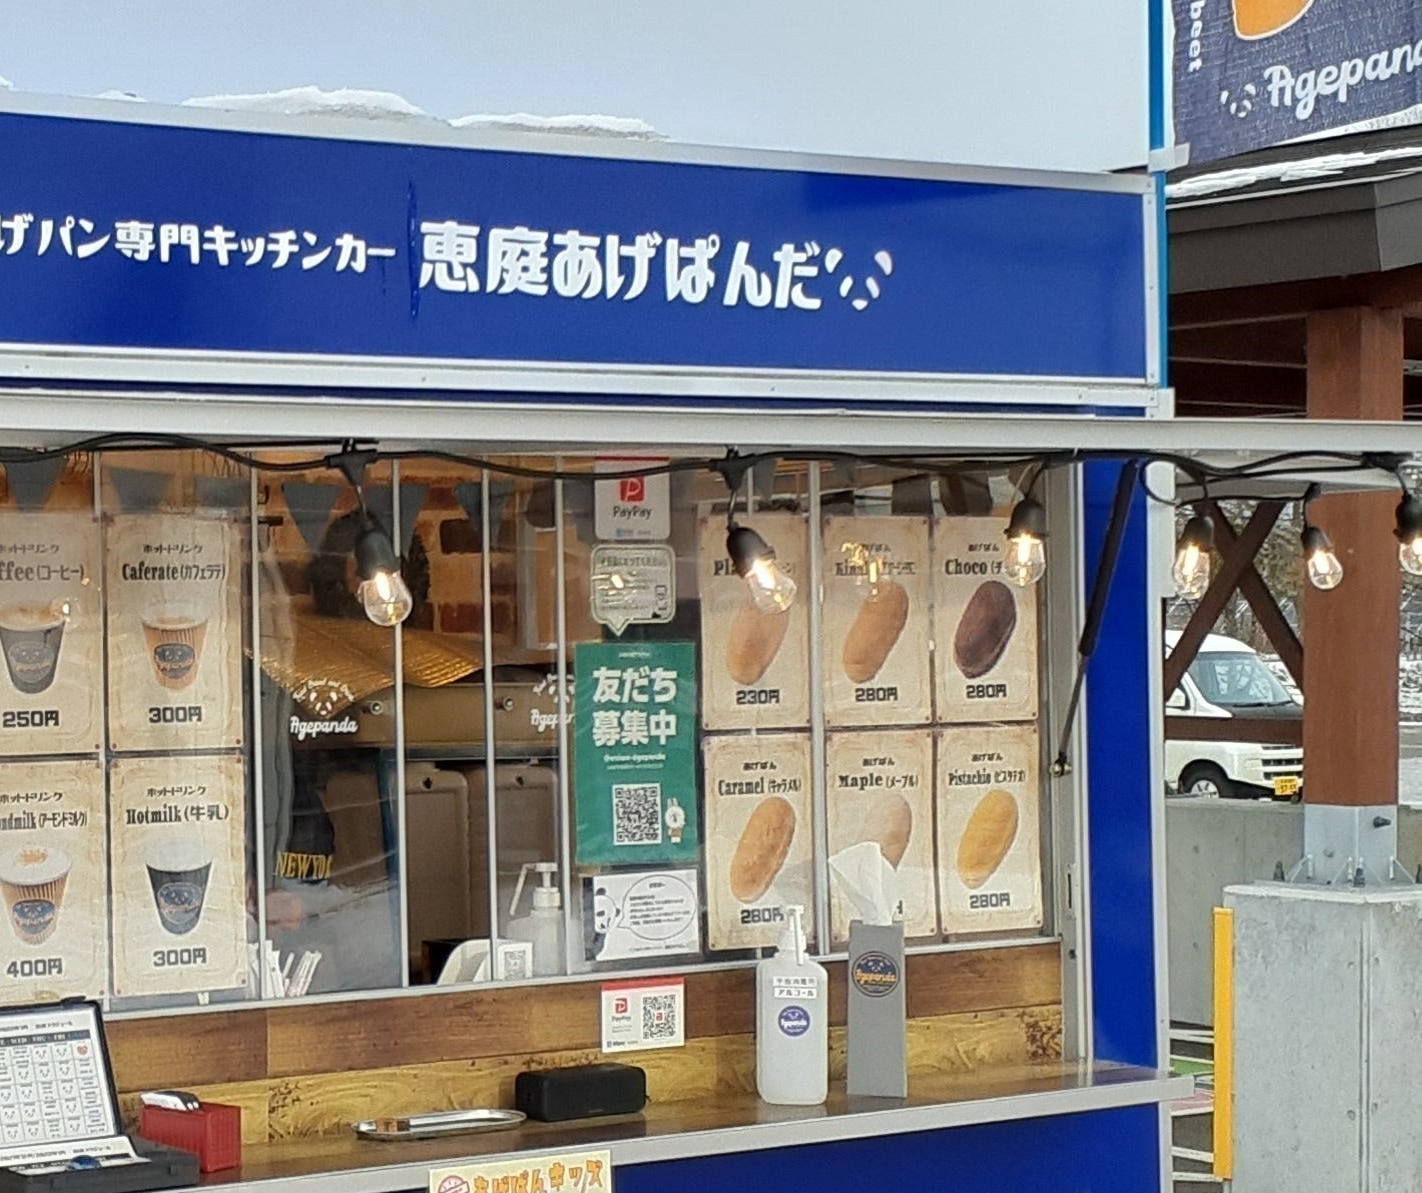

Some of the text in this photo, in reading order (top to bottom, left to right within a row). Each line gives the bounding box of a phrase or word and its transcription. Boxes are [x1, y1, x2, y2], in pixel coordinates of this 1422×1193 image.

[419, 220, 840, 312] 恵庭あげぱんだ
[612, 505, 653, 520] PayPay
[945, 558, 987, 575] Choco
[592, 665, 678, 703] 友だち
[966, 684, 1007, 699] 280円
[736, 688, 781, 705] 230円
[854, 686, 899, 702] 280円
[2, 710, 60, 728] 250円
[149, 706, 203, 723] 300円
[290, 715, 359, 741] Agepanda
[592, 708, 677, 747] 募集中
[718, 776, 765, 796] Caramel
[838, 772, 884, 791] Maple
[125, 803, 230, 825] Hotmilk (牛乳)
[969, 892, 1011, 910] 280円
[152, 947, 207, 967] 300円
[6, 957, 64, 978] 400円
